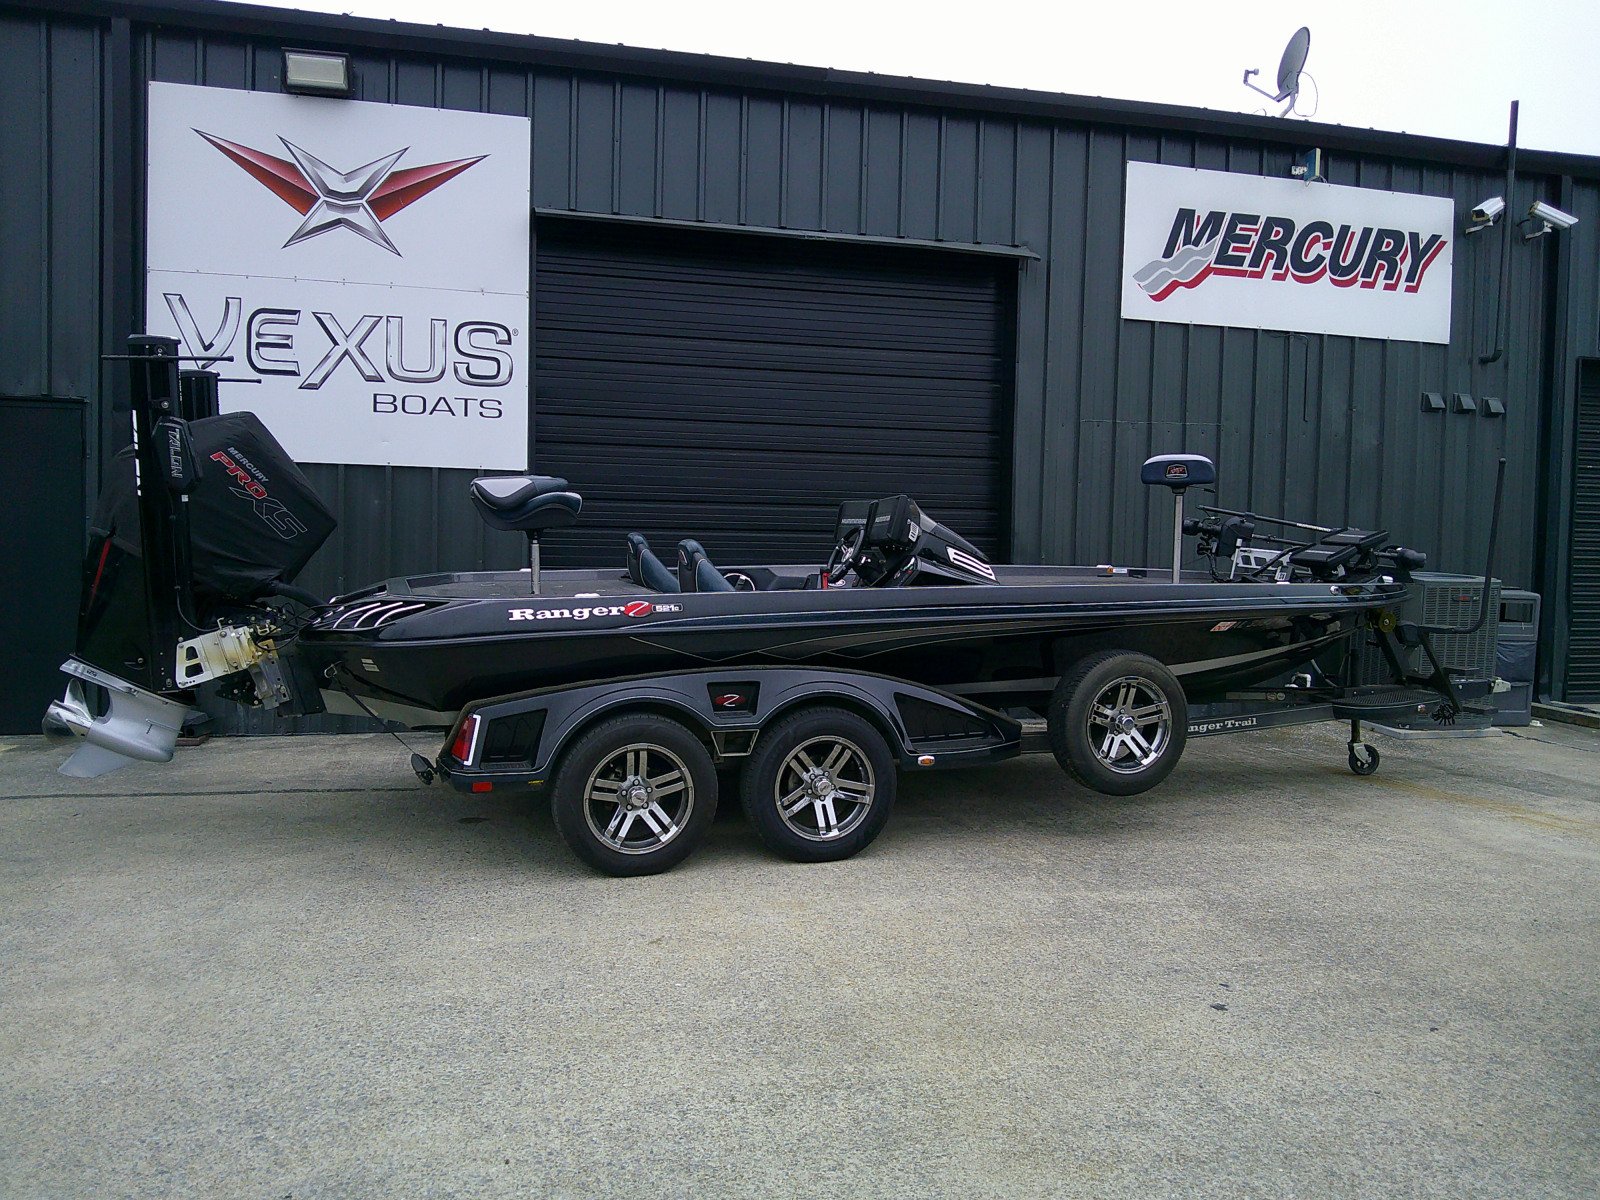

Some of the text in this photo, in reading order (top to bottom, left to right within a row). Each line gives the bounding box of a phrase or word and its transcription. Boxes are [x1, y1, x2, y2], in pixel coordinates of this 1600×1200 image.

[1161, 207, 1447, 294] MERCURY
[372, 393, 503, 419] BOATS
[167, 428, 183, 479] TALON
[227, 446, 269, 483] MERCURY
[210, 451, 267, 500] PRO
[508, 606, 625, 621] Ranger
[1225, 717, 1258, 728] Trail
